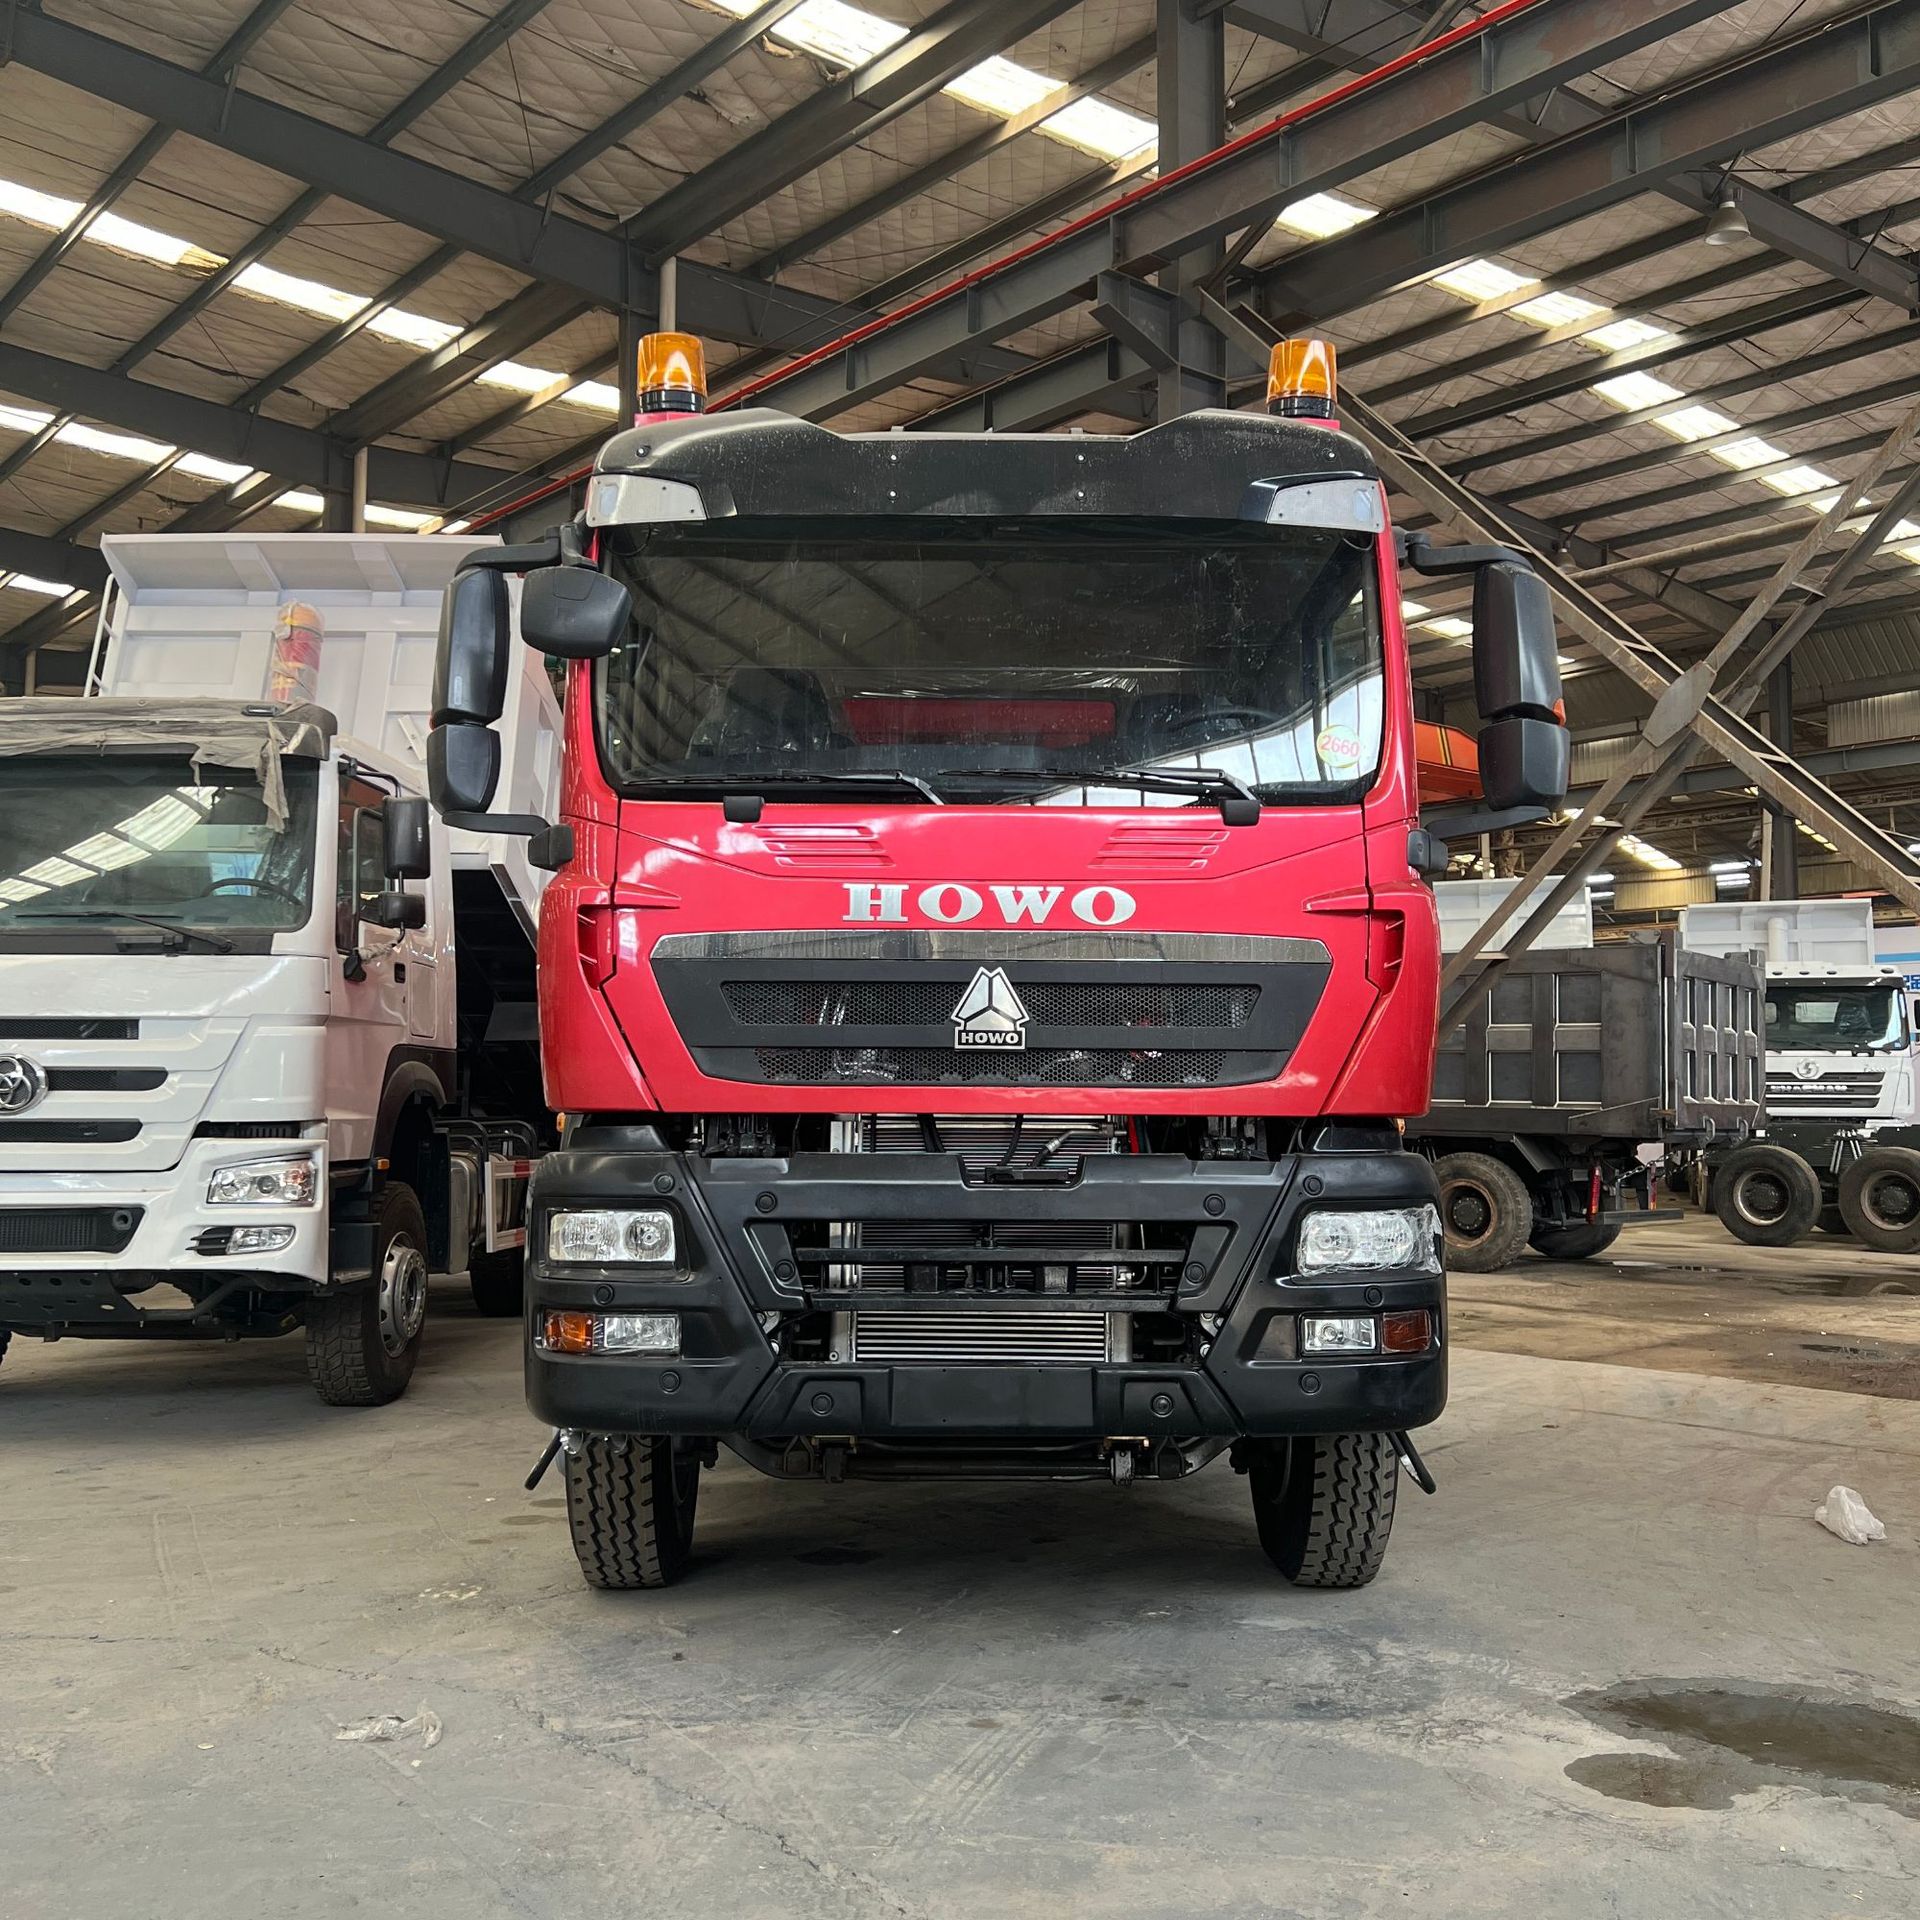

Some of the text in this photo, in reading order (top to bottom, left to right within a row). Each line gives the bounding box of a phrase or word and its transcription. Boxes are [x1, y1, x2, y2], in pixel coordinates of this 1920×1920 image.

[1320, 735, 1360, 757] 2660
[842, 882, 1137, 926] HOWO
[961, 1032, 1019, 1044] HOWO
